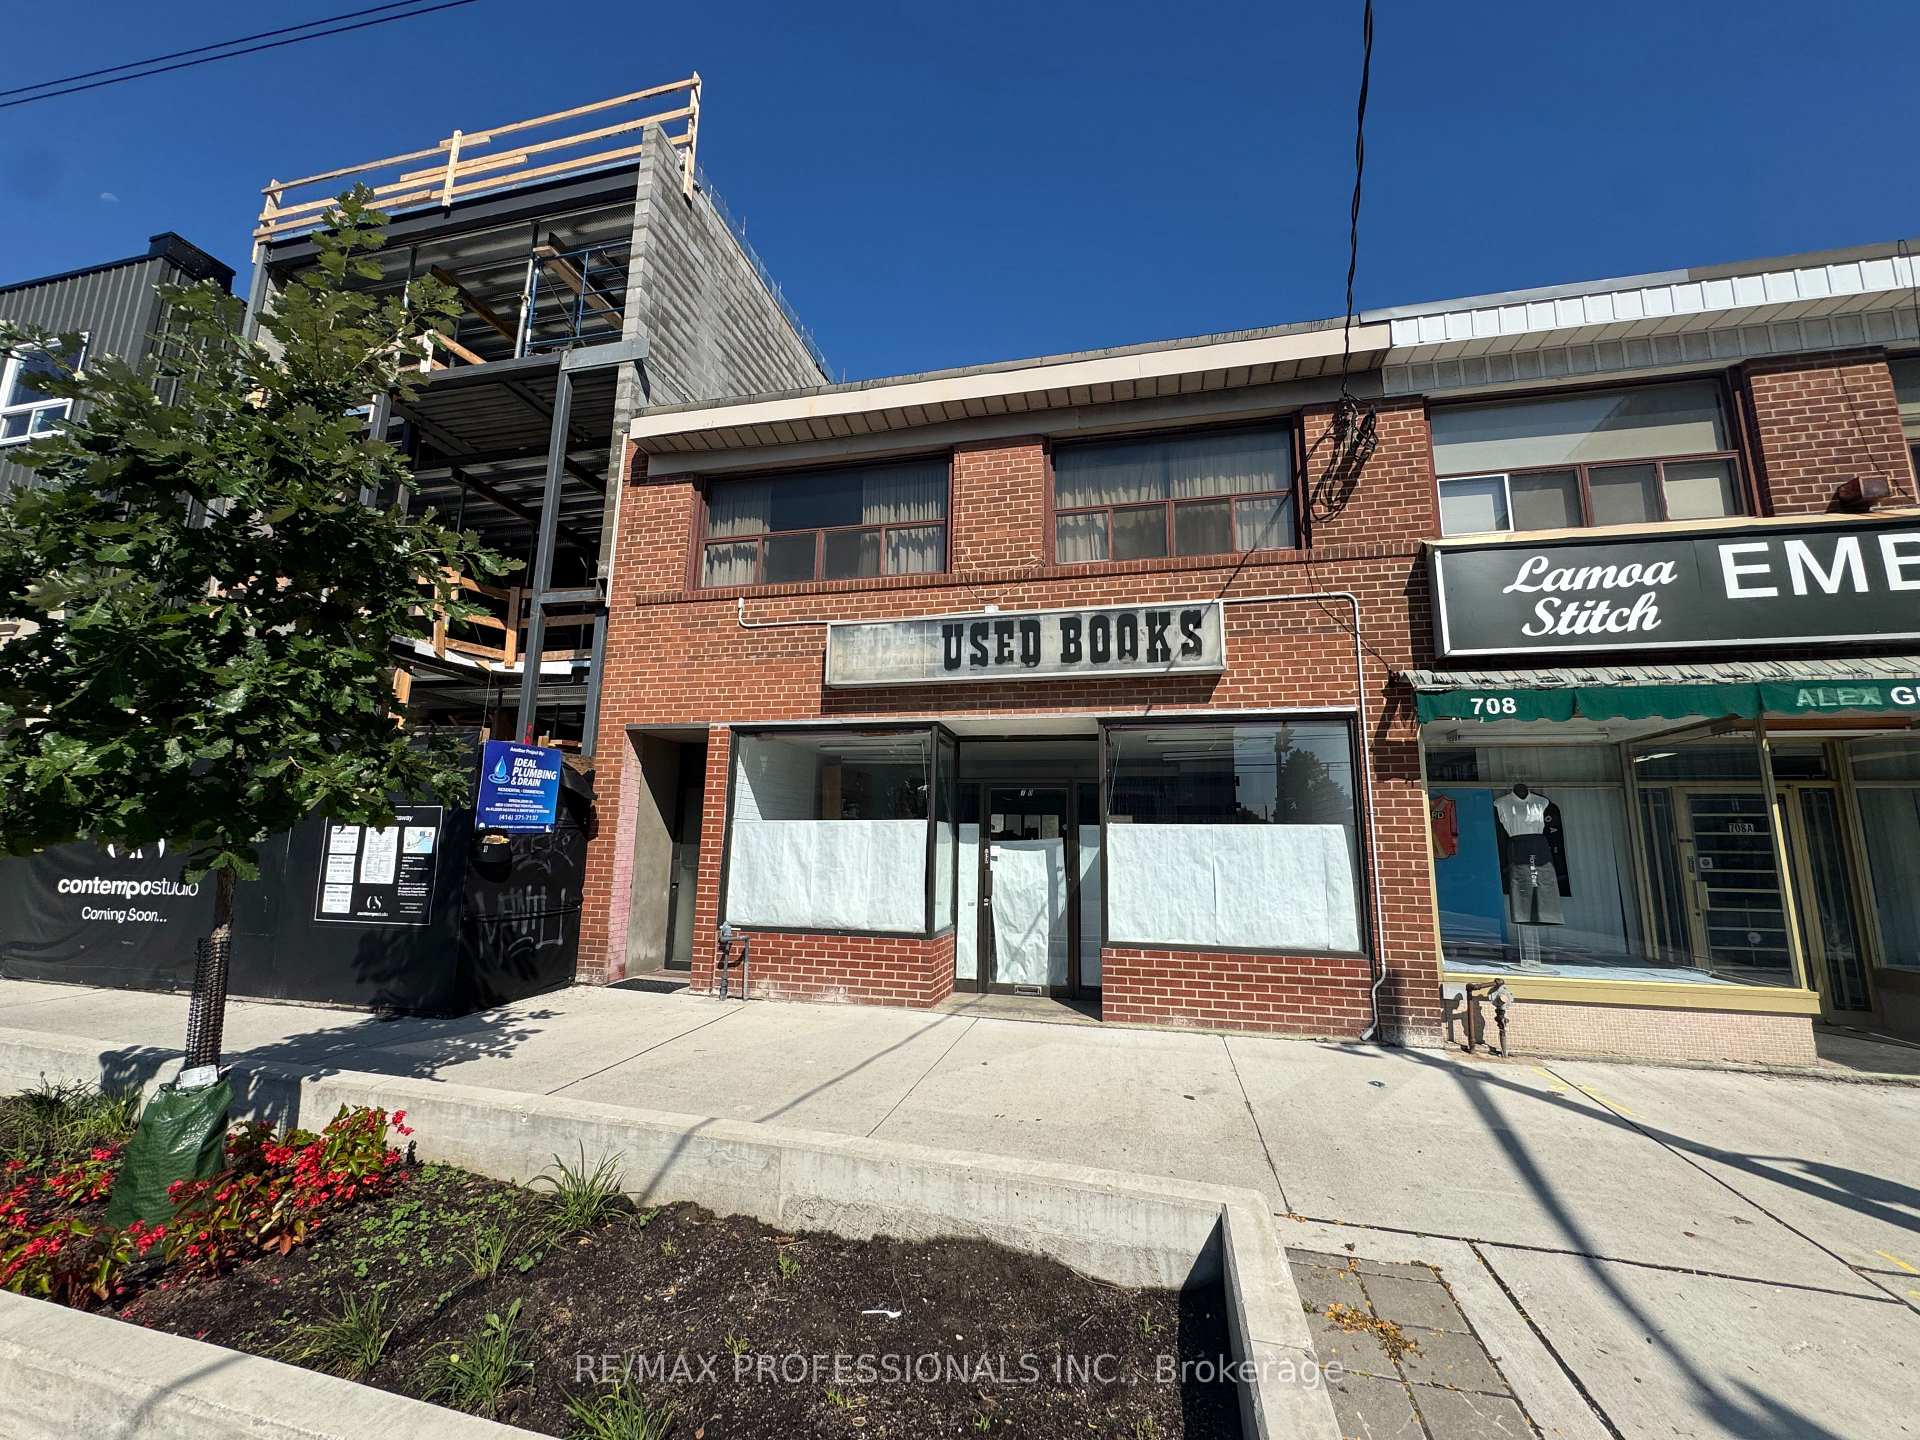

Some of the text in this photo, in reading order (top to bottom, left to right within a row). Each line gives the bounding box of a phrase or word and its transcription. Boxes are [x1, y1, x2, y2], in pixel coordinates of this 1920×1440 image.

[1502, 555, 1678, 594] Lamoa
[1520, 591, 1662, 636] Stitch
[942, 615, 1041, 671] USED
[1060, 609, 1203, 664] BOOKS
[1470, 697, 1517, 715] 708
[514, 757, 537, 768] IDEAL
[510, 776, 541, 786] & DRAIN
[511, 766, 558, 780] PLUMBING
[57, 876, 199, 900] contempostudio
[81, 906, 168, 924] Coming Soon...
